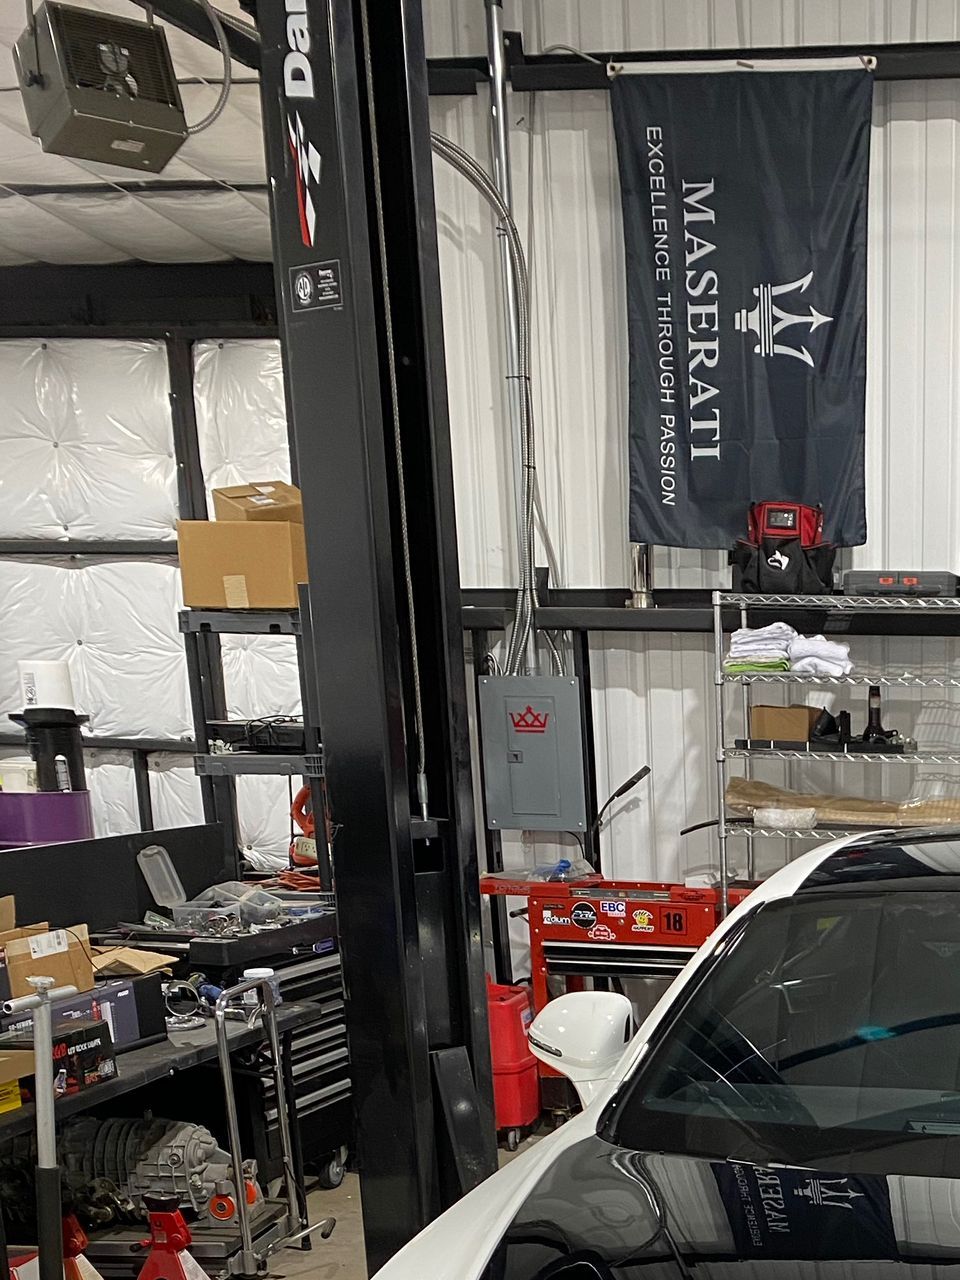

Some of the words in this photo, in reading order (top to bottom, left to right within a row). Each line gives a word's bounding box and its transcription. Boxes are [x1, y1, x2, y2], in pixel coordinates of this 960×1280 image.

[646, 126, 671, 281] EXCELLENCE
[657, 292, 675, 403] THROUGH
[681, 177, 721, 461] MASERATI
[660, 414, 676, 506] PASSION
[601, 902, 625, 912] EBC
[663, 912, 683, 931] 18
